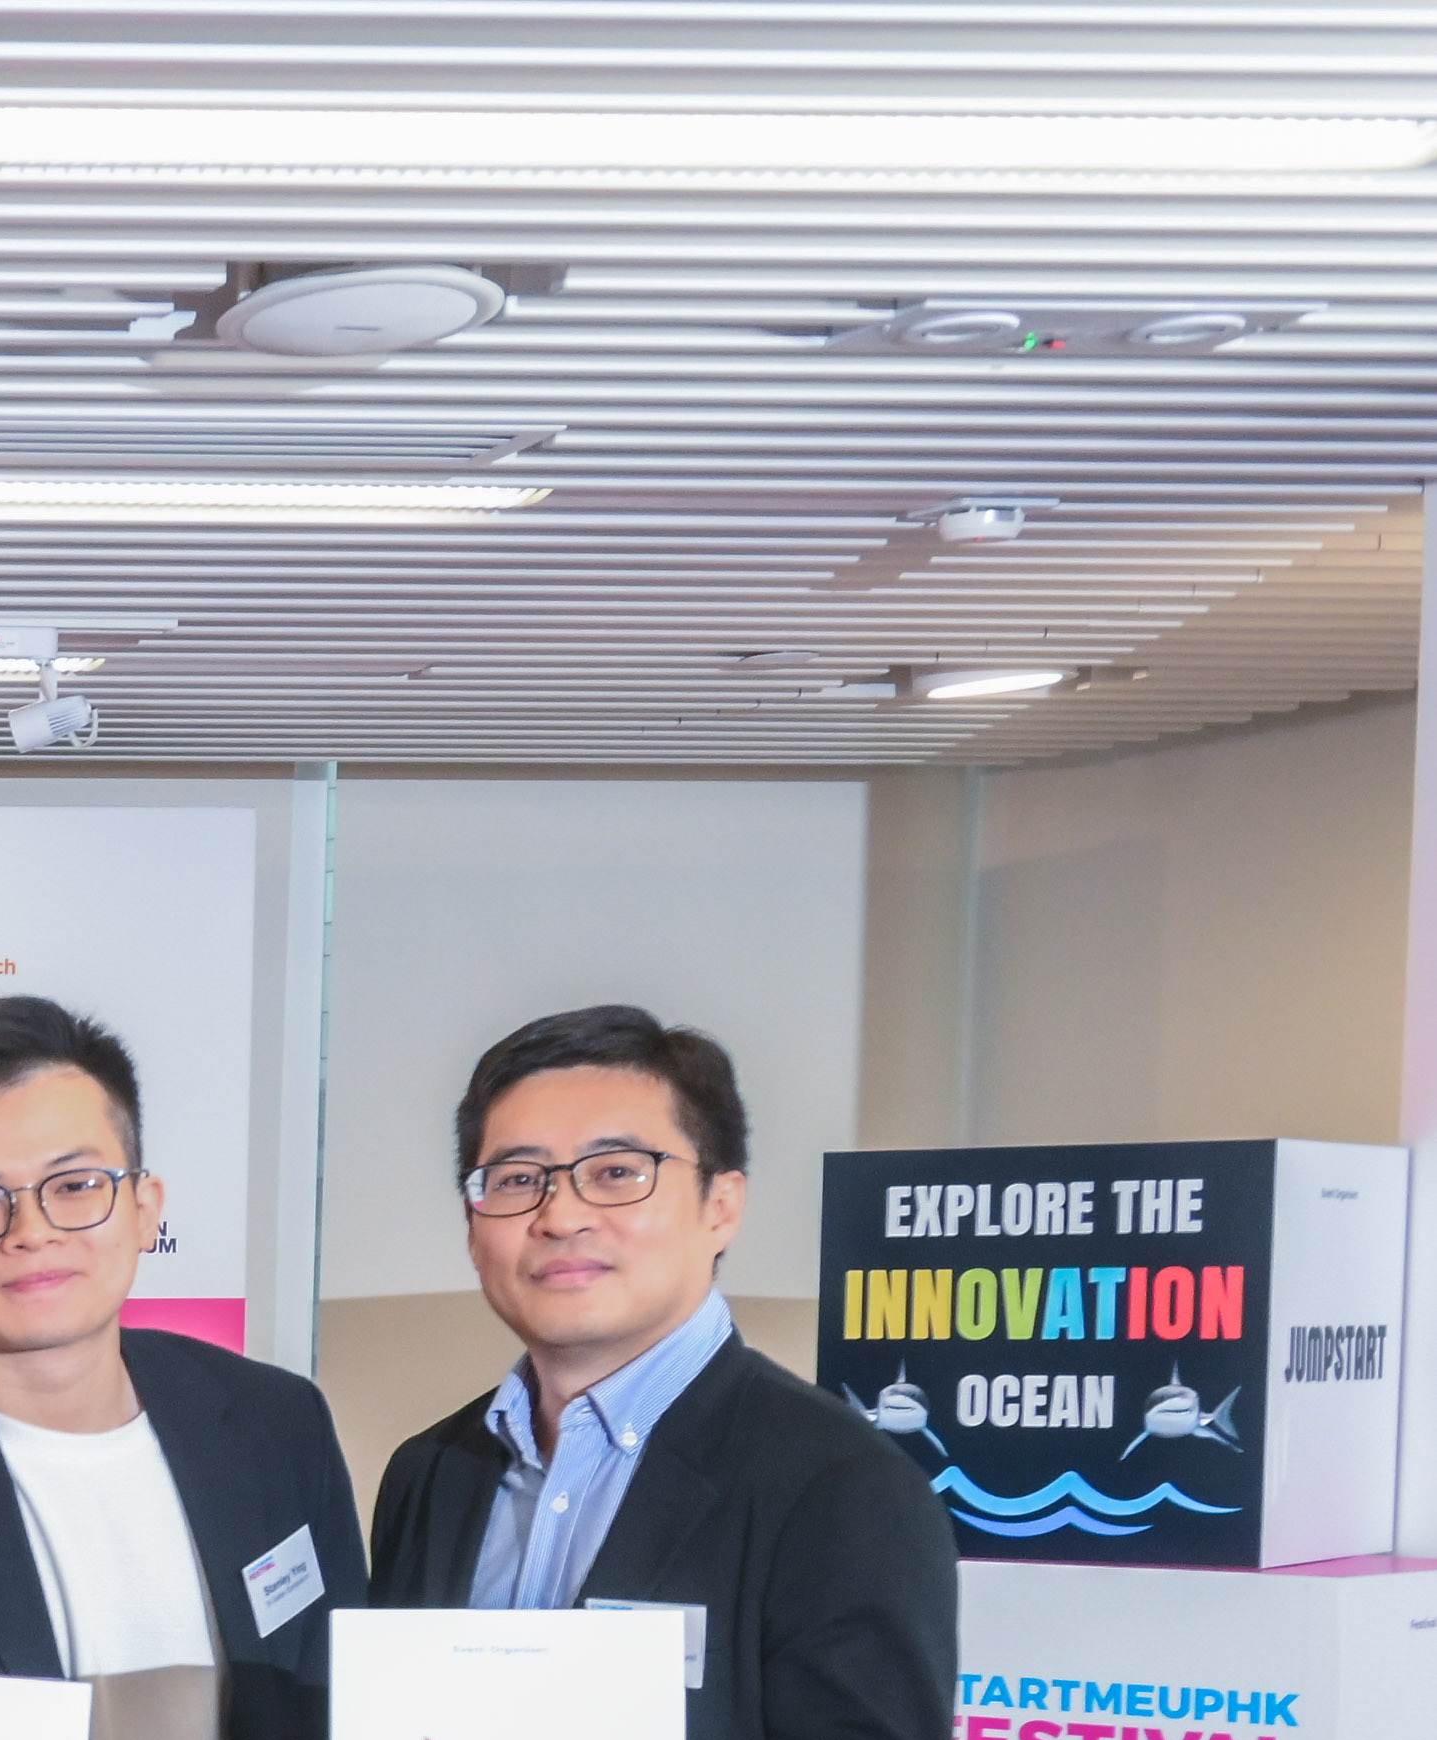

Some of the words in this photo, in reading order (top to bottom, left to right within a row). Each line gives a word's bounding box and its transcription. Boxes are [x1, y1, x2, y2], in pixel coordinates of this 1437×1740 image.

[885, 1180, 1095, 1239] EXPLORE
[1112, 1179, 1204, 1234] THE
[843, 1265, 1244, 1341] INNOVATION
[1285, 1325, 1388, 1385] JUMPSTART
[956, 1375, 1115, 1430] OCEAN
